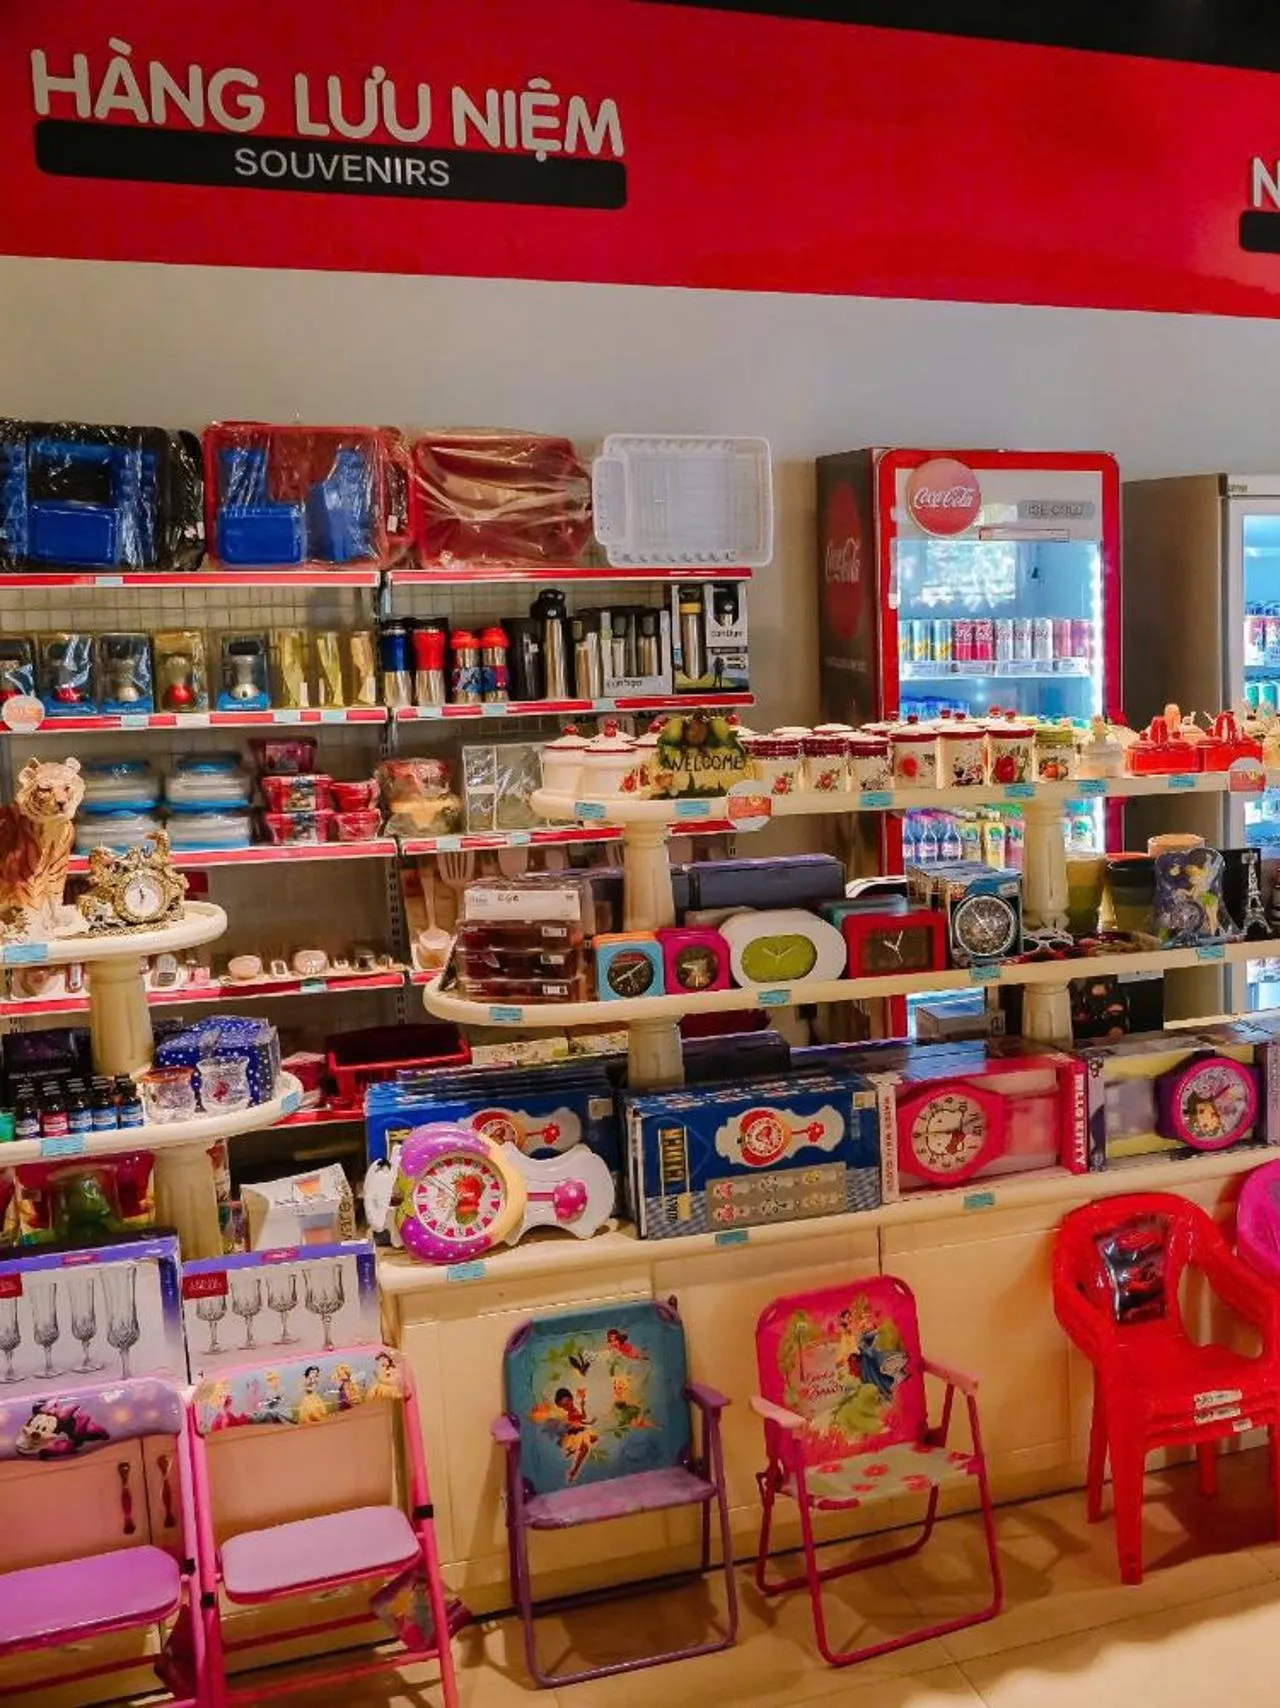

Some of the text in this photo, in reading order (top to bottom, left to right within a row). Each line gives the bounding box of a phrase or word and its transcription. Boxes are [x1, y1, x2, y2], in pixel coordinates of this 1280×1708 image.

[30, 37, 625, 162] HÀNG LƯU NIỆM
[233, 147, 451, 188] SOUVENIRS
[914, 487, 974, 509] Coca-Cola
[666, 752, 745, 772] WELCOME
[1074, 1073, 1086, 1165] HELLO KITTY
